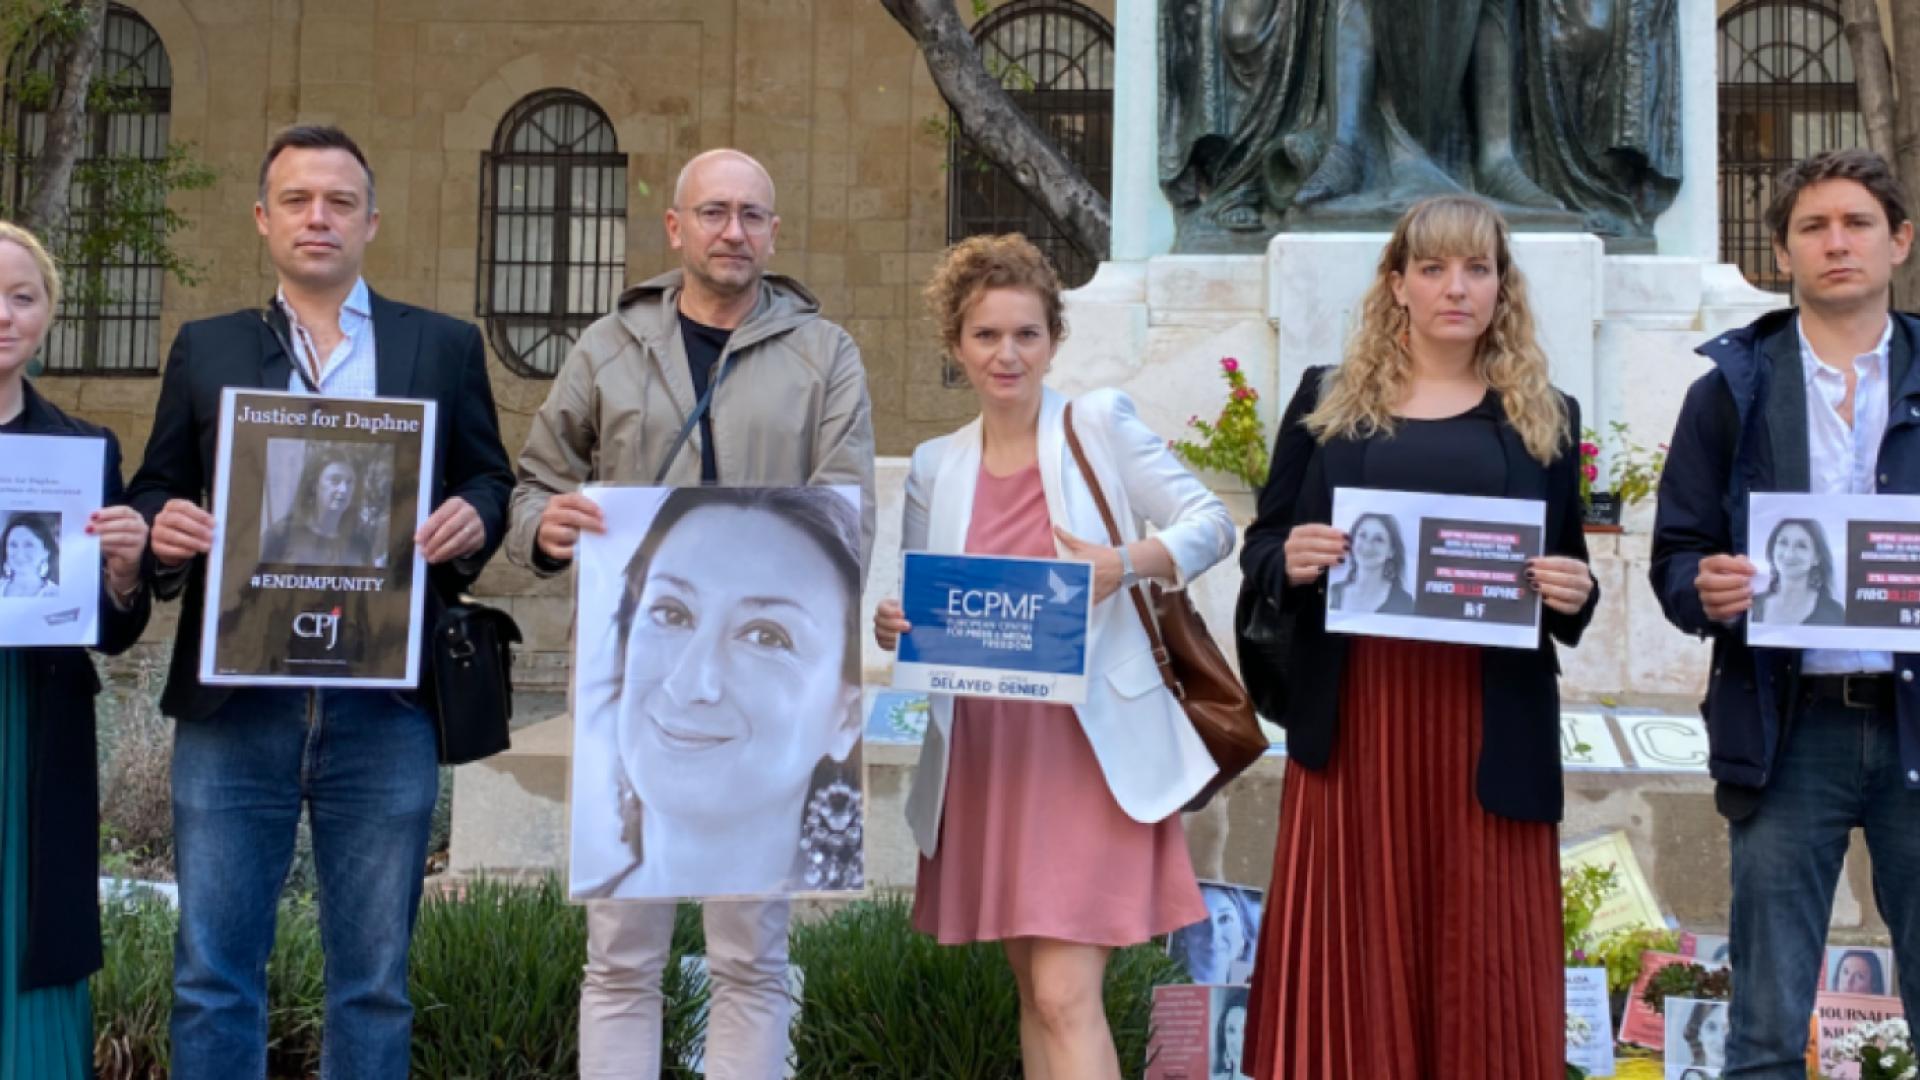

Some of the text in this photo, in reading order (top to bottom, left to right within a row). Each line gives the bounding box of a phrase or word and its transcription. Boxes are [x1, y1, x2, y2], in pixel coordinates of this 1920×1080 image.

[238, 405, 420, 434] Justice for Daphne
[250, 573, 385, 592] #ENDIMPUNITY
[948, 589, 1044, 620] ECPMF
[930, 677, 992, 692] DELAYED
[998, 681, 1049, 697] DENIED
